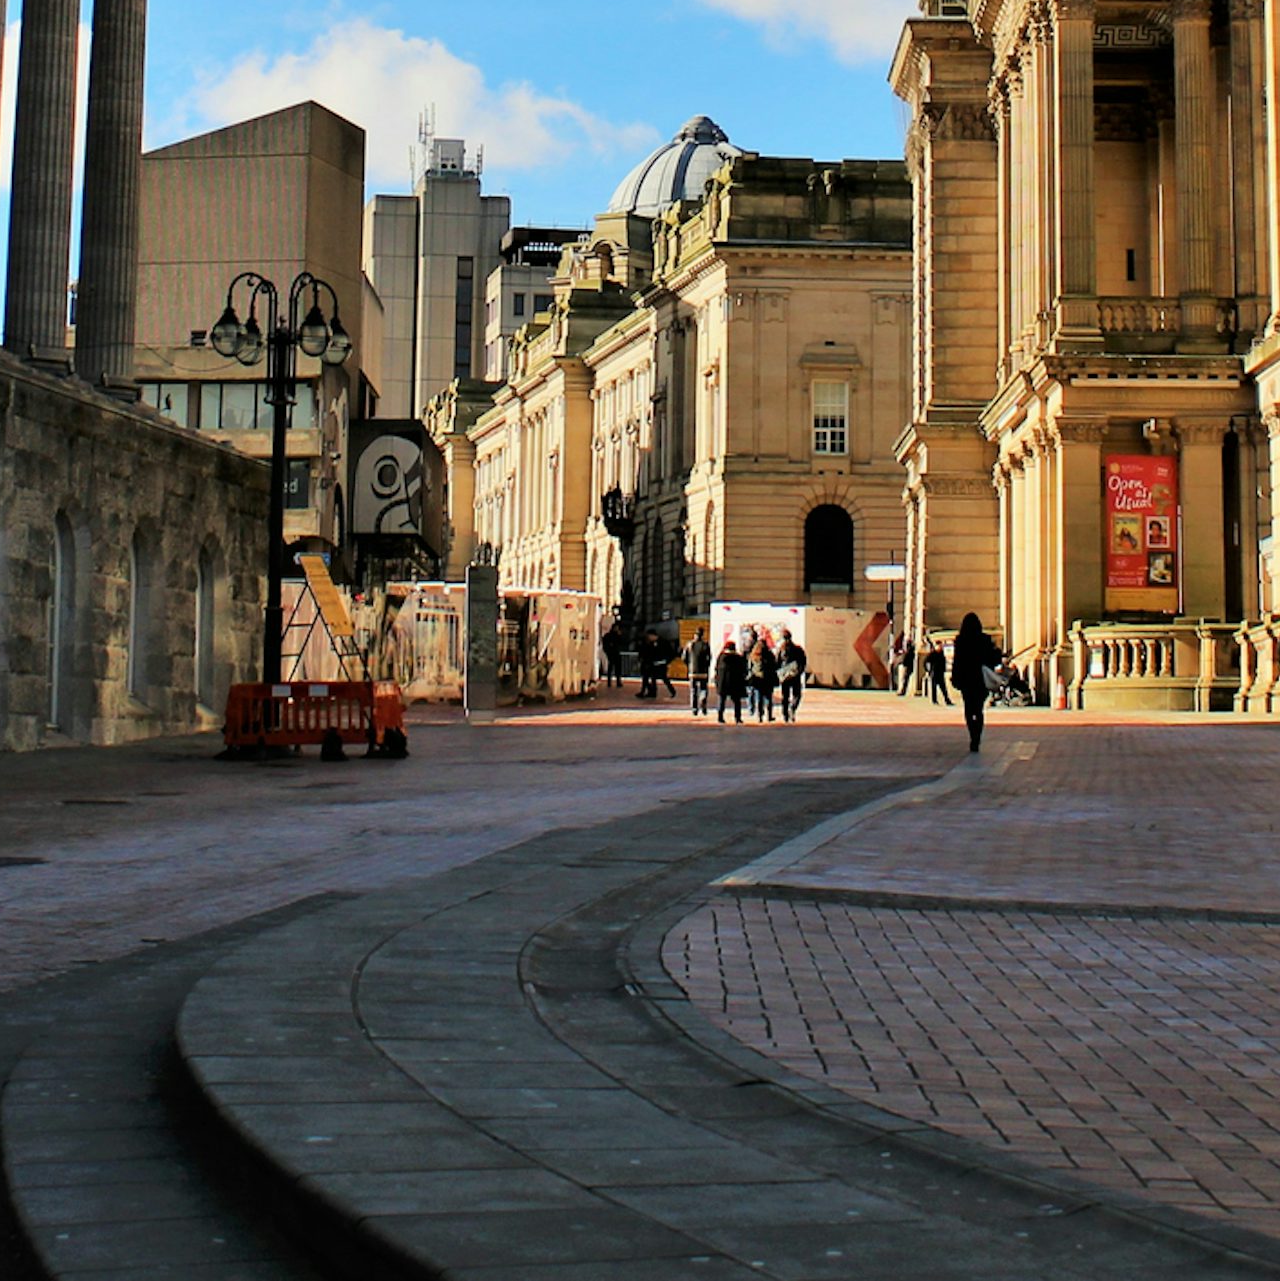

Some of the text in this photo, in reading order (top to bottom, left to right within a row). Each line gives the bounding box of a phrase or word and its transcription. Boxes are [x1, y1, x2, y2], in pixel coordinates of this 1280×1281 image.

[1108, 475, 1144, 497] Open
[1135, 487, 1148, 498] as
[1114, 491, 1153, 510] Usual
